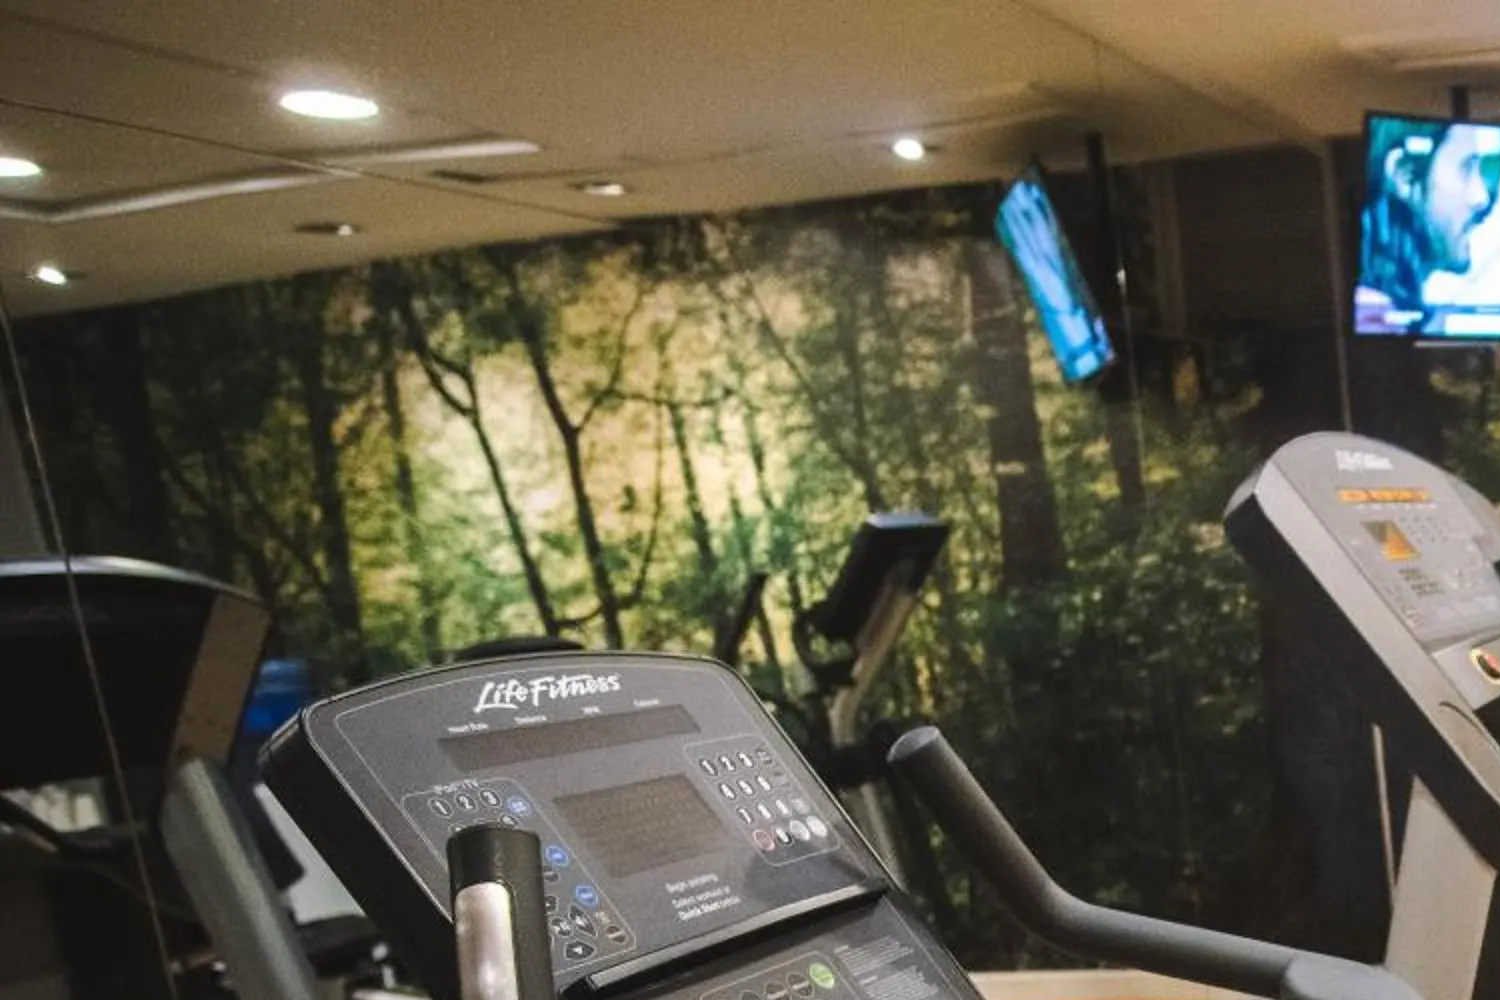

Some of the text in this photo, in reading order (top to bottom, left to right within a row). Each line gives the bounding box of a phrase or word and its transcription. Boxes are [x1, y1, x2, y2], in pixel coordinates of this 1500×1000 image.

[473, 674, 621, 713] Life Fitness
[720, 755, 736, 771] 2
[434, 801, 449, 816] 1
[457, 794, 474, 810] 2
